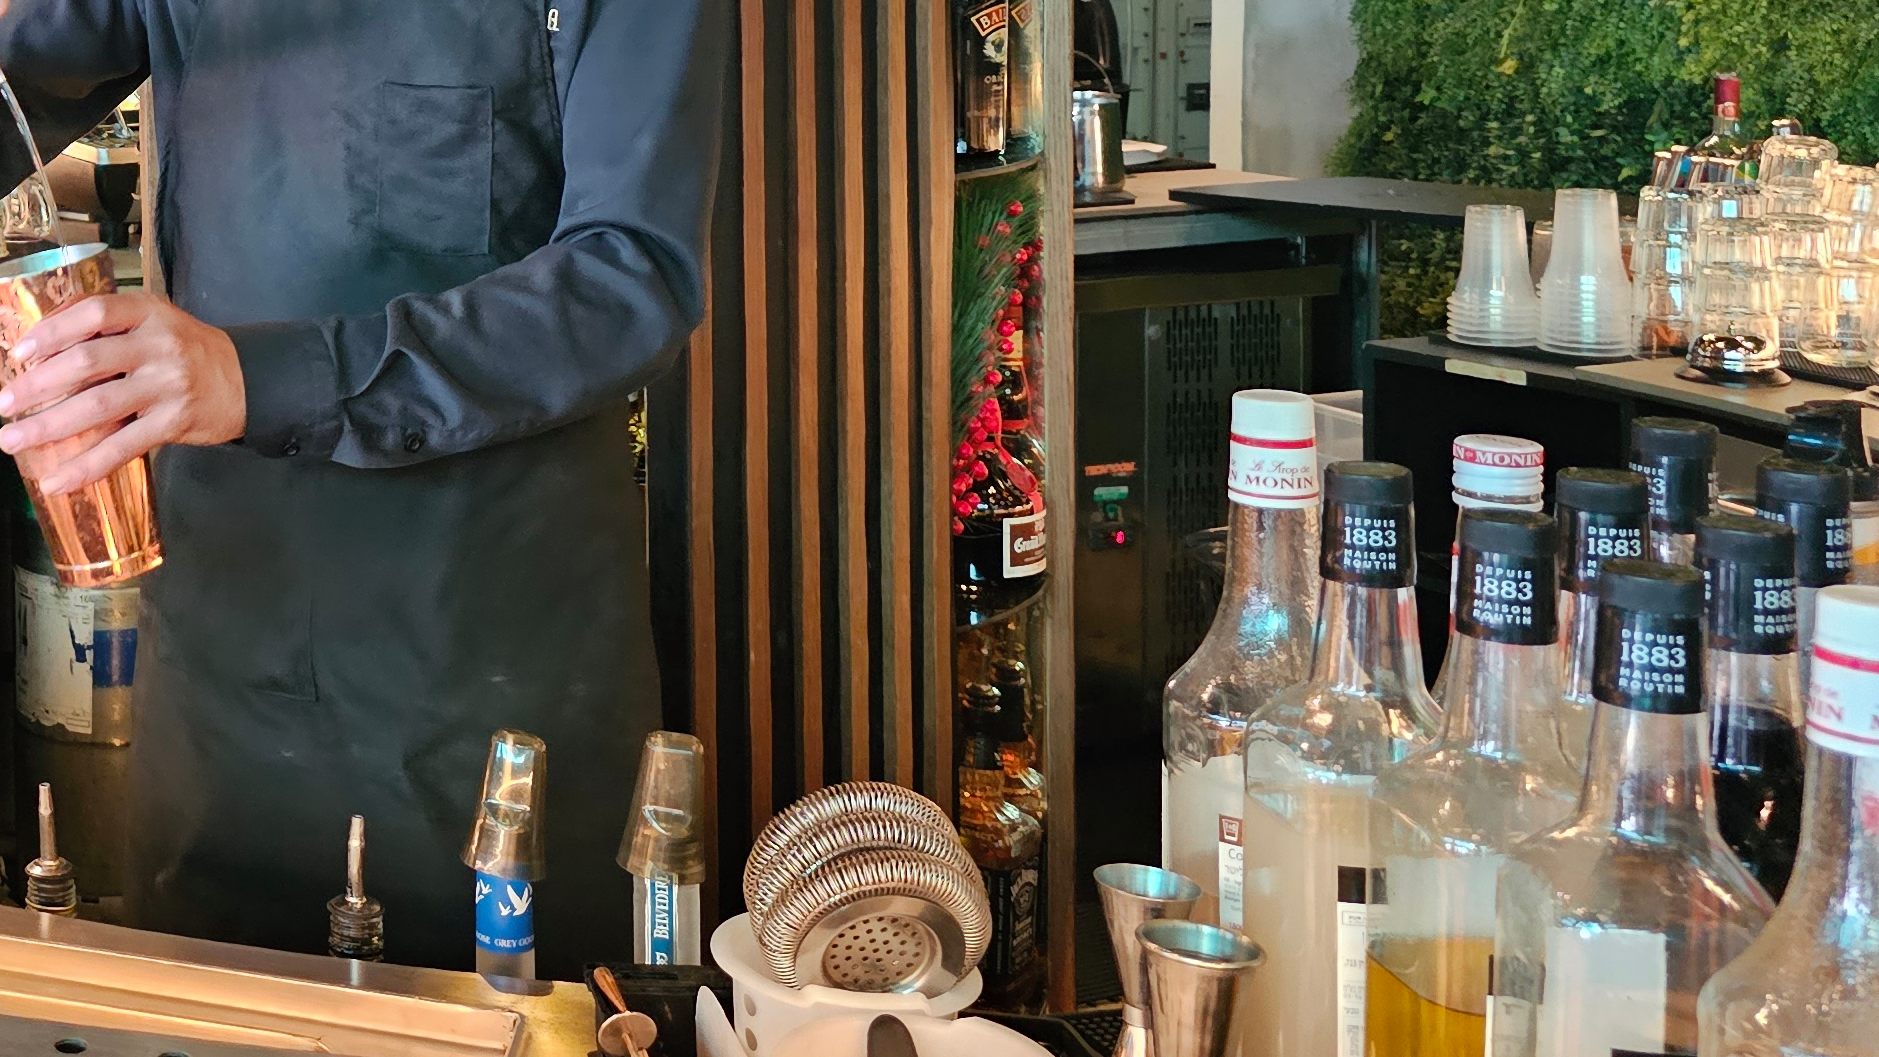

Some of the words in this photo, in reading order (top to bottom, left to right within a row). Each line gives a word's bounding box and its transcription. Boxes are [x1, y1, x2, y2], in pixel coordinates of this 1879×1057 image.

[1475, 450, 1541, 467] MONIN
[1245, 474, 1314, 490] MONIN
[1344, 515, 1397, 529] DEPUIS
[1343, 526, 1397, 548] 1883
[1587, 525, 1641, 538] DEPUIS
[1343, 548, 1397, 561] MAISON
[1587, 537, 1642, 557] 1883
[1343, 557, 1397, 571] ROUTIN
[1475, 563, 1533, 580] DEPUIS
[1473, 575, 1534, 601] 1883
[1473, 598, 1532, 616] MAISON
[1472, 608, 1532, 626] ROUTIN
[1621, 628, 1686, 646] DEPUIS
[1620, 641, 1687, 669] 1883
[1619, 666, 1686, 683] MAISON
[1618, 677, 1686, 695] ROUTIN
[494, 938, 517, 948] GREY
